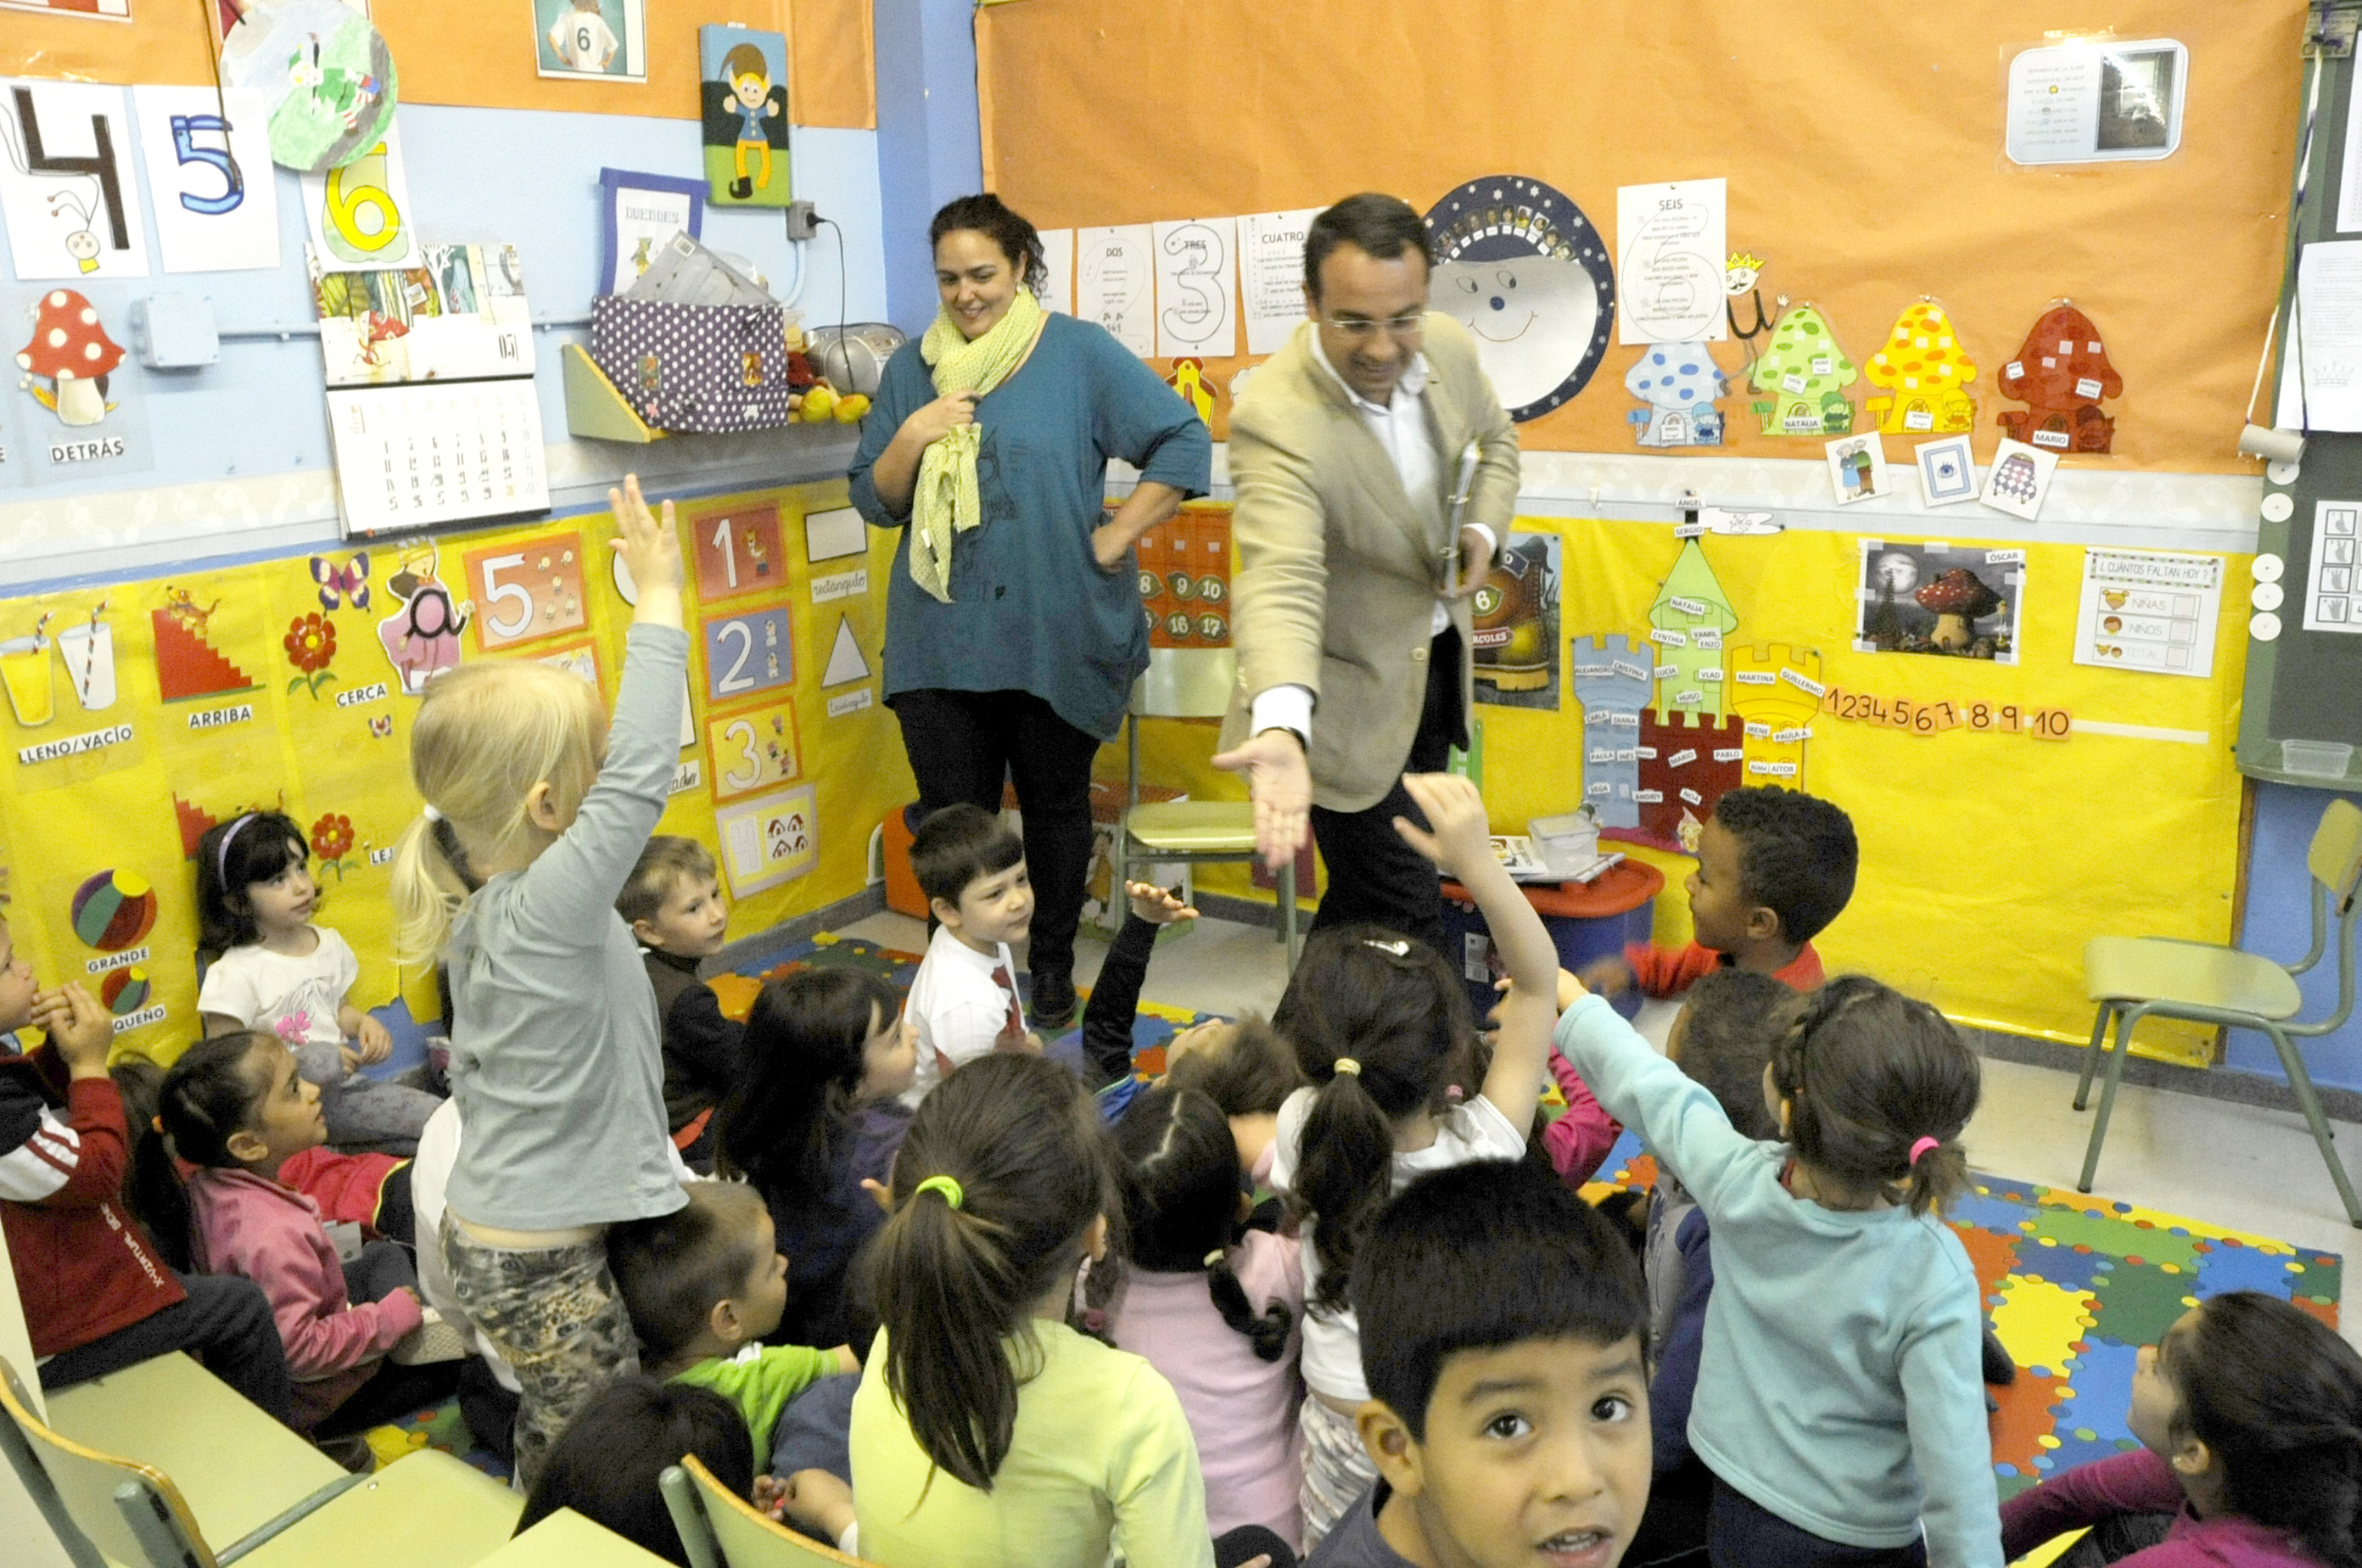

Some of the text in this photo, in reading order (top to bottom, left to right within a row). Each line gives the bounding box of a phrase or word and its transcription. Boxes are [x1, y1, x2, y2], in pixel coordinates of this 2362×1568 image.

[577, 27, 590, 51] 6
[13, 88, 130, 250] 4
[170, 115, 244, 216] 5
[326, 143, 400, 252] 6
[1659, 199, 1683, 210] SEIS
[1184, 240, 1206, 249] TRES
[1262, 232, 1304, 244] CUATRO
[1105, 248, 1123, 257] DOS
[2035, 434, 2066, 445] MARIO
[52, 438, 125, 462] DETRÁS
[1678, 499, 1703, 507] ÁNGEL
[1676, 526, 1703, 536] SERGIO
[712, 518, 738, 590] 1
[1990, 552, 2019, 563] ÓSCAR
[2147, 564, 2180, 578] FALTAN
[2183, 568, 2199, 579] HOY
[1139, 576, 1221, 599] 8 9 10
[482, 552, 535, 638] 5
[1475, 590, 1491, 610] 6
[1671, 599, 1704, 613] NATALIA
[2132, 598, 2166, 611] NIÑAS
[1170, 615, 1189, 634] 16
[1202, 617, 1221, 636] 17
[2130, 623, 2163, 636] NIÑOS
[1653, 631, 1685, 645] CYNTHIA
[1700, 640, 1721, 648] ENZO
[718, 620, 755, 694] 2
[2126, 647, 2158, 659] TOTAL
[1575, 665, 1614, 674] ALEJANDRO
[1614, 662, 1645, 678] CRISTINA
[1656, 667, 1677, 677] LUCÍA
[1700, 670, 1721, 679] VLAD
[1738, 673, 1774, 682] MARTINA
[1782, 669, 1824, 695] GUILLERMO
[337, 684, 387, 708] CERCA
[1678, 692, 1700, 702] HUGO
[189, 706, 251, 728] ARRIBA
[1586, 712, 1607, 722] CARLA
[1828, 688, 2070, 736] 1 2 3 4 5 6 7 8 9 10
[1748, 725, 1768, 735] IRENE
[1775, 731, 1799, 741] PAULA
[20, 726, 132, 764] LLENO/VACÍO
[725, 720, 762, 790] 3
[1670, 752, 1694, 764] MARIO
[1716, 750, 1740, 759] PABLO
[1589, 785, 1609, 793] VEGA
[1683, 790, 1699, 802] NOA
[88, 948, 148, 972] GRANDE
[114, 1007, 165, 1032] QUEÑO
